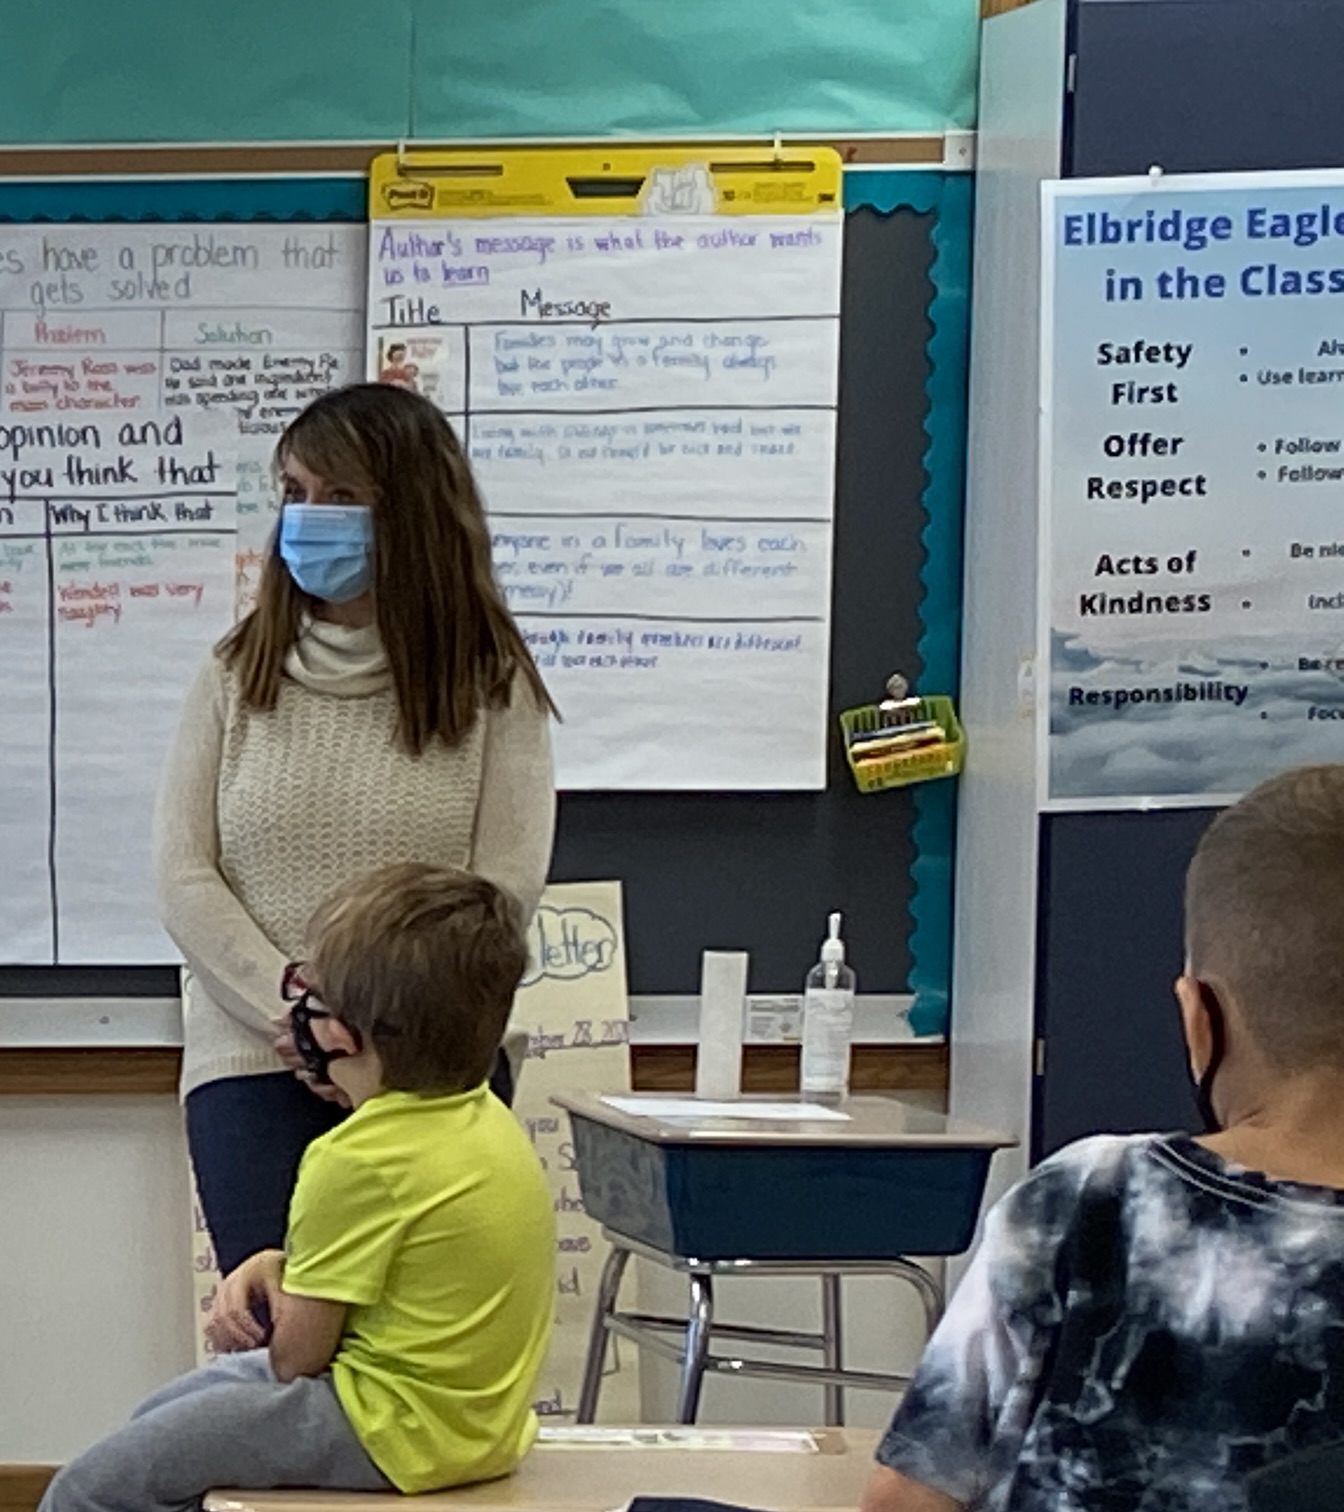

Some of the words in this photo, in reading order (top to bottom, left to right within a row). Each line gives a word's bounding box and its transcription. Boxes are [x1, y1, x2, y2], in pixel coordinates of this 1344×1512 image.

[378, 225, 462, 261] Author's
[475, 234, 556, 265] message
[568, 235, 584, 250] is
[594, 229, 642, 250] what
[654, 228, 685, 249] the
[697, 228, 759, 249] author
[770, 227, 822, 249] wants
[1063, 209, 1233, 251] Elbridge
[42, 236, 99, 273] have
[118, 247, 135, 270] a
[152, 234, 259, 287] problem
[282, 234, 340, 269] that
[384, 267, 405, 286] us
[413, 260, 431, 283] to
[442, 260, 490, 286] learn
[31, 274, 85, 319] gets
[109, 271, 191, 300] solved
[1105, 268, 1143, 302] in
[1156, 266, 1226, 300] the
[380, 294, 441, 325] Title
[520, 287, 611, 331] Message
[169, 356, 202, 373] Dad
[1096, 339, 1193, 369] Safety
[1256, 369, 1293, 385] Use
[1111, 381, 1179, 406] First
[118, 414, 183, 446] and
[1103, 432, 1185, 458] Offer
[1274, 437, 1341, 455] Follow
[1, 466, 55, 504] you
[64, 454, 139, 486] think
[153, 450, 223, 486] that
[1086, 474, 1207, 504] Respect
[50, 504, 92, 532] Why
[96, 502, 110, 523] I
[113, 503, 168, 523] think
[174, 499, 215, 521] that
[591, 535, 607, 549] a
[614, 522, 687, 560] family
[757, 534, 808, 552] each
[702, 557, 799, 579] different
[1095, 555, 1159, 577] Acts
[1167, 550, 1197, 574] of
[1290, 543, 1314, 558] Be
[1079, 592, 1212, 617] Kindness
[1298, 657, 1321, 671] Be
[1068, 682, 1249, 709] Responsibility
[537, 912, 614, 968] letter
